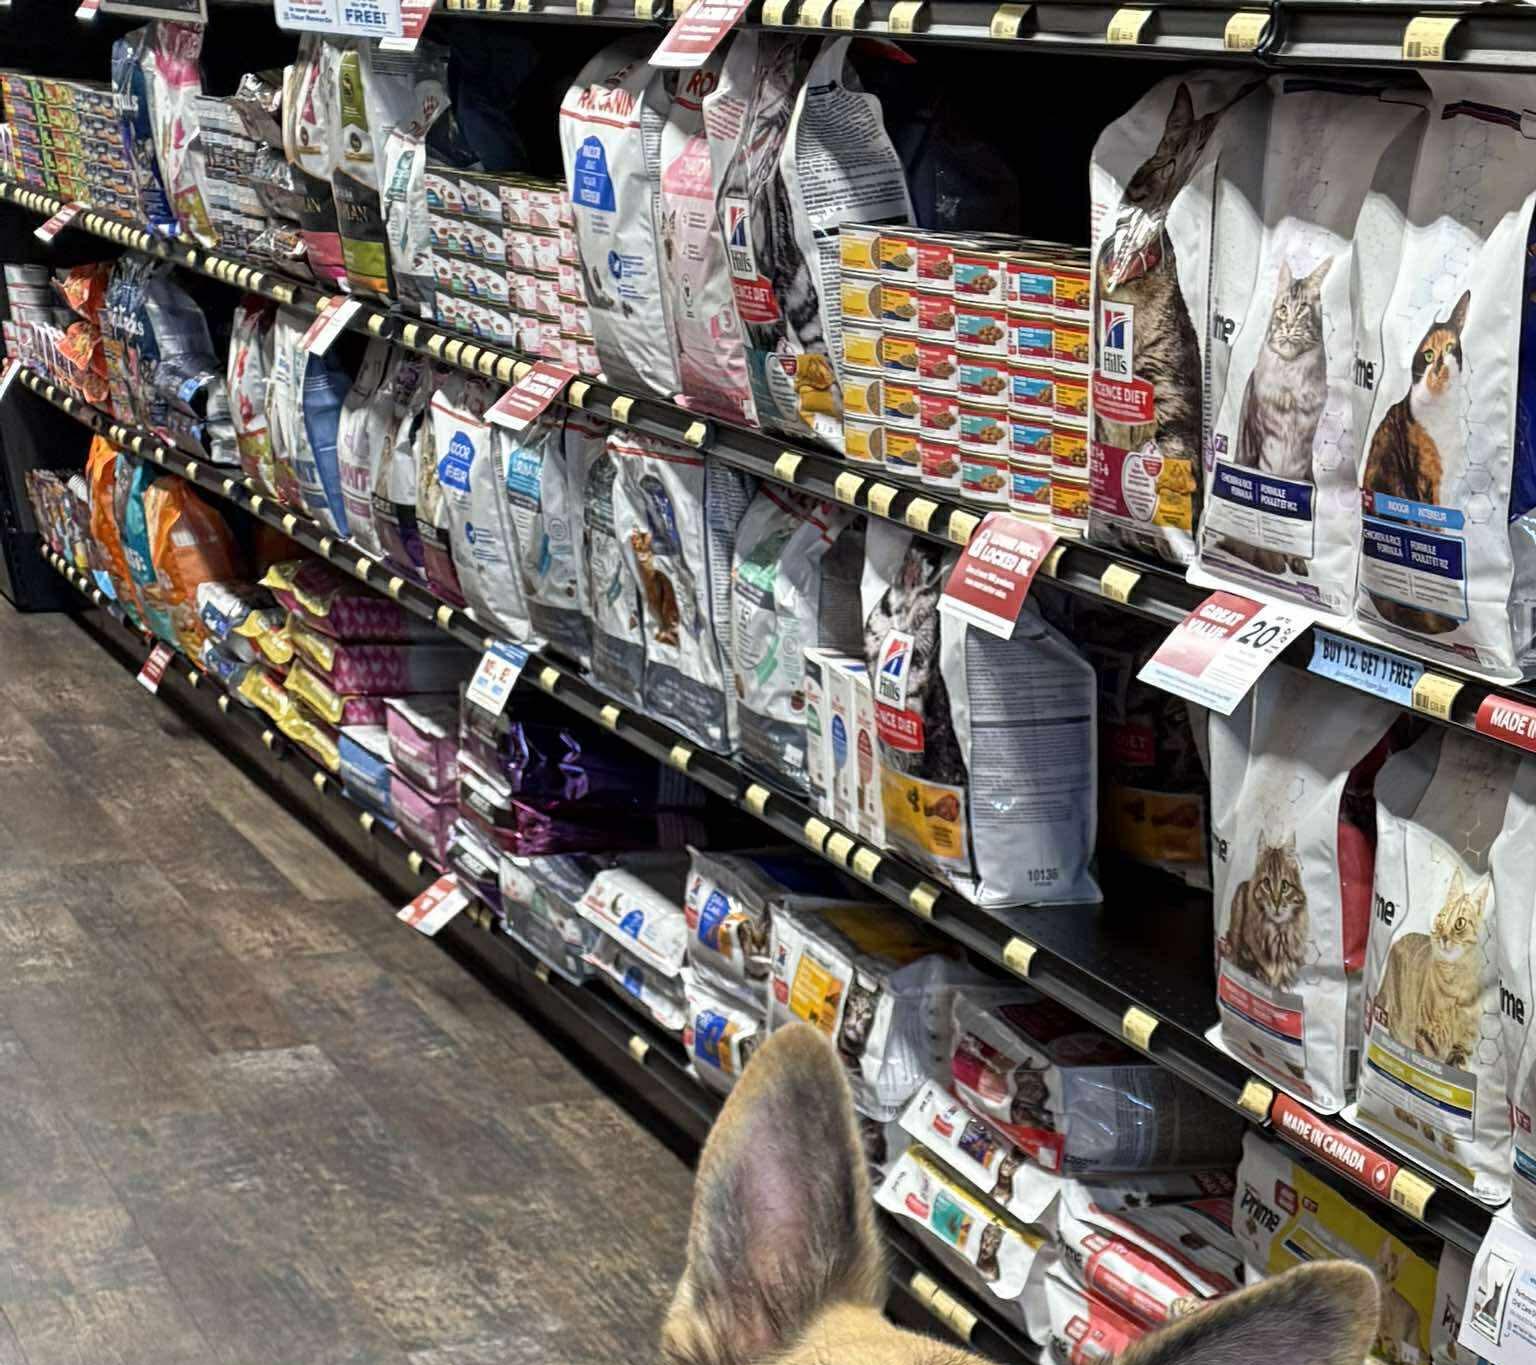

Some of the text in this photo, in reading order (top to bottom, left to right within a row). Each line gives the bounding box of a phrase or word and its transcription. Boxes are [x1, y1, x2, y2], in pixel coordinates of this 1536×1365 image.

[1124, 387, 1148, 406] DIET
[1323, 637, 1343, 664] BUY
[1344, 644, 1358, 672] 12,
[1360, 652, 1379, 677] GET
[1390, 660, 1417, 689] FREE
[1490, 707, 1529, 736] MADE
[1282, 1111, 1366, 1173] MADE IN CANADA
